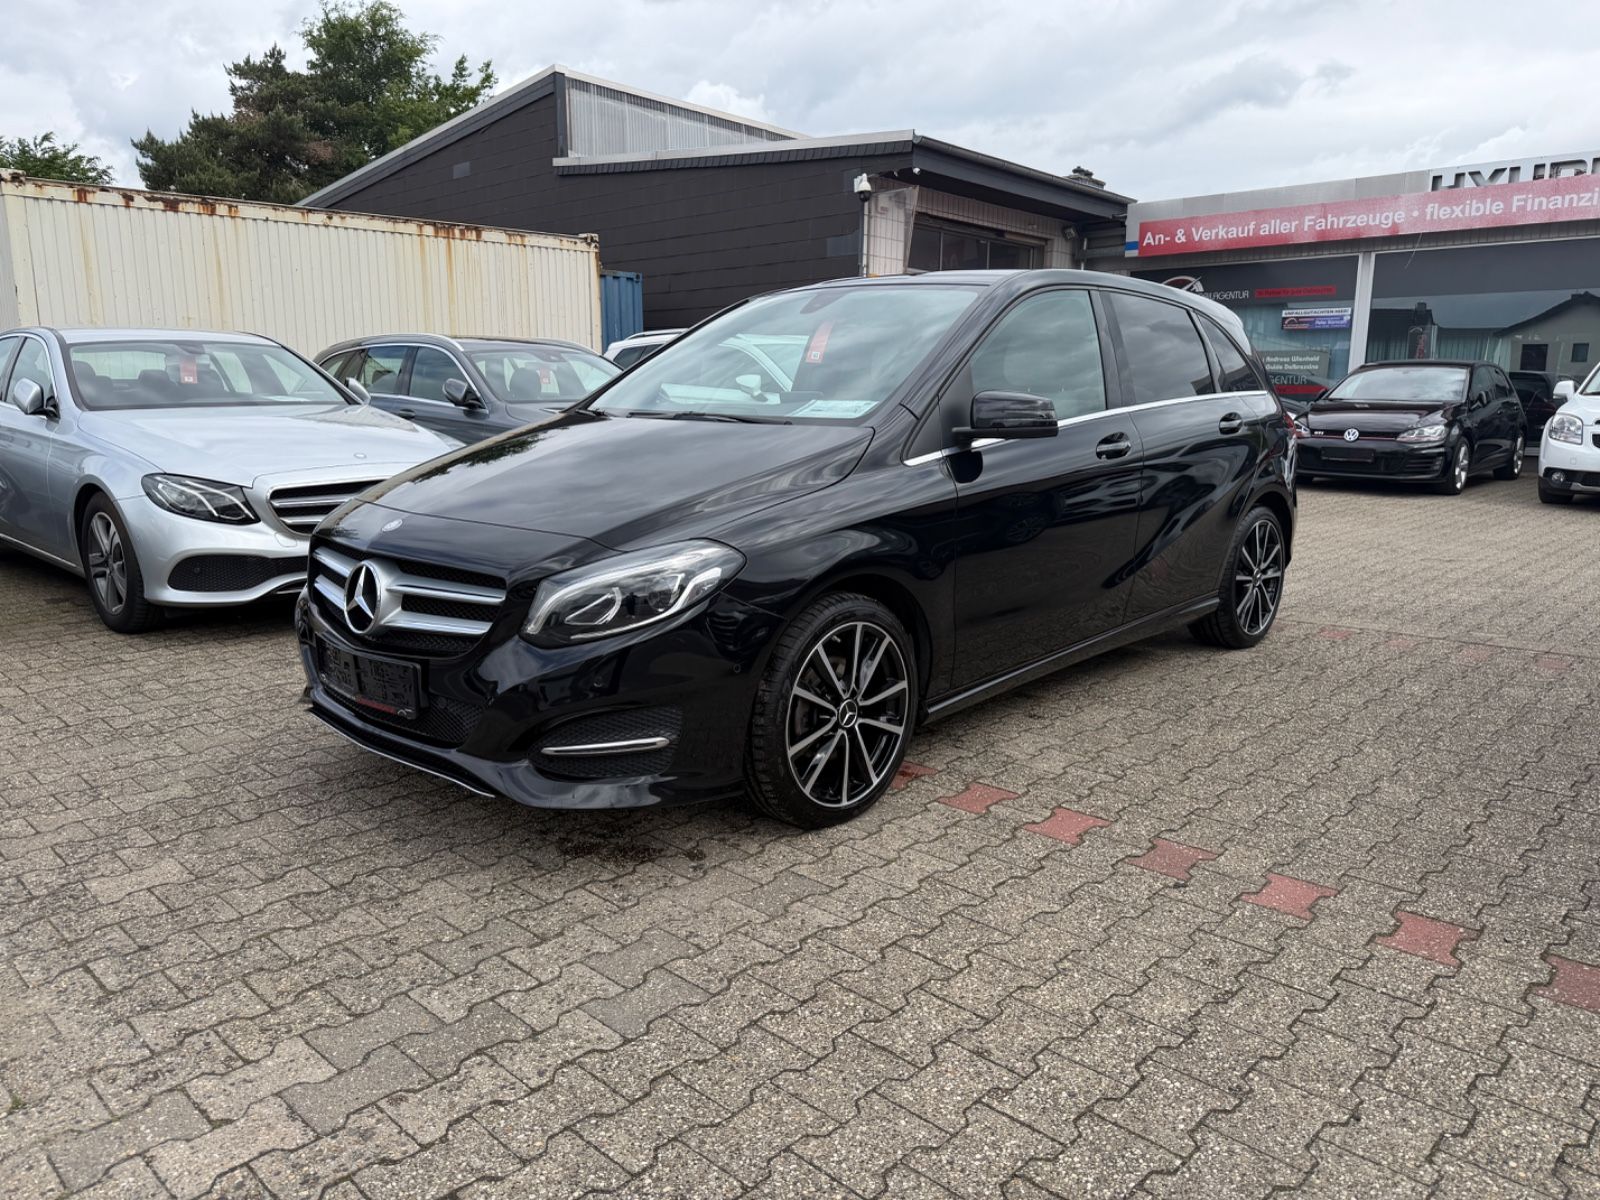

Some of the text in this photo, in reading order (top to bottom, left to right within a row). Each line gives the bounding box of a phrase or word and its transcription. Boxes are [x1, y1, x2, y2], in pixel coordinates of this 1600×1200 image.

[1143, 188, 1600, 247] An- & Verkauf aller Fahrzeuge flexible Finanzi
